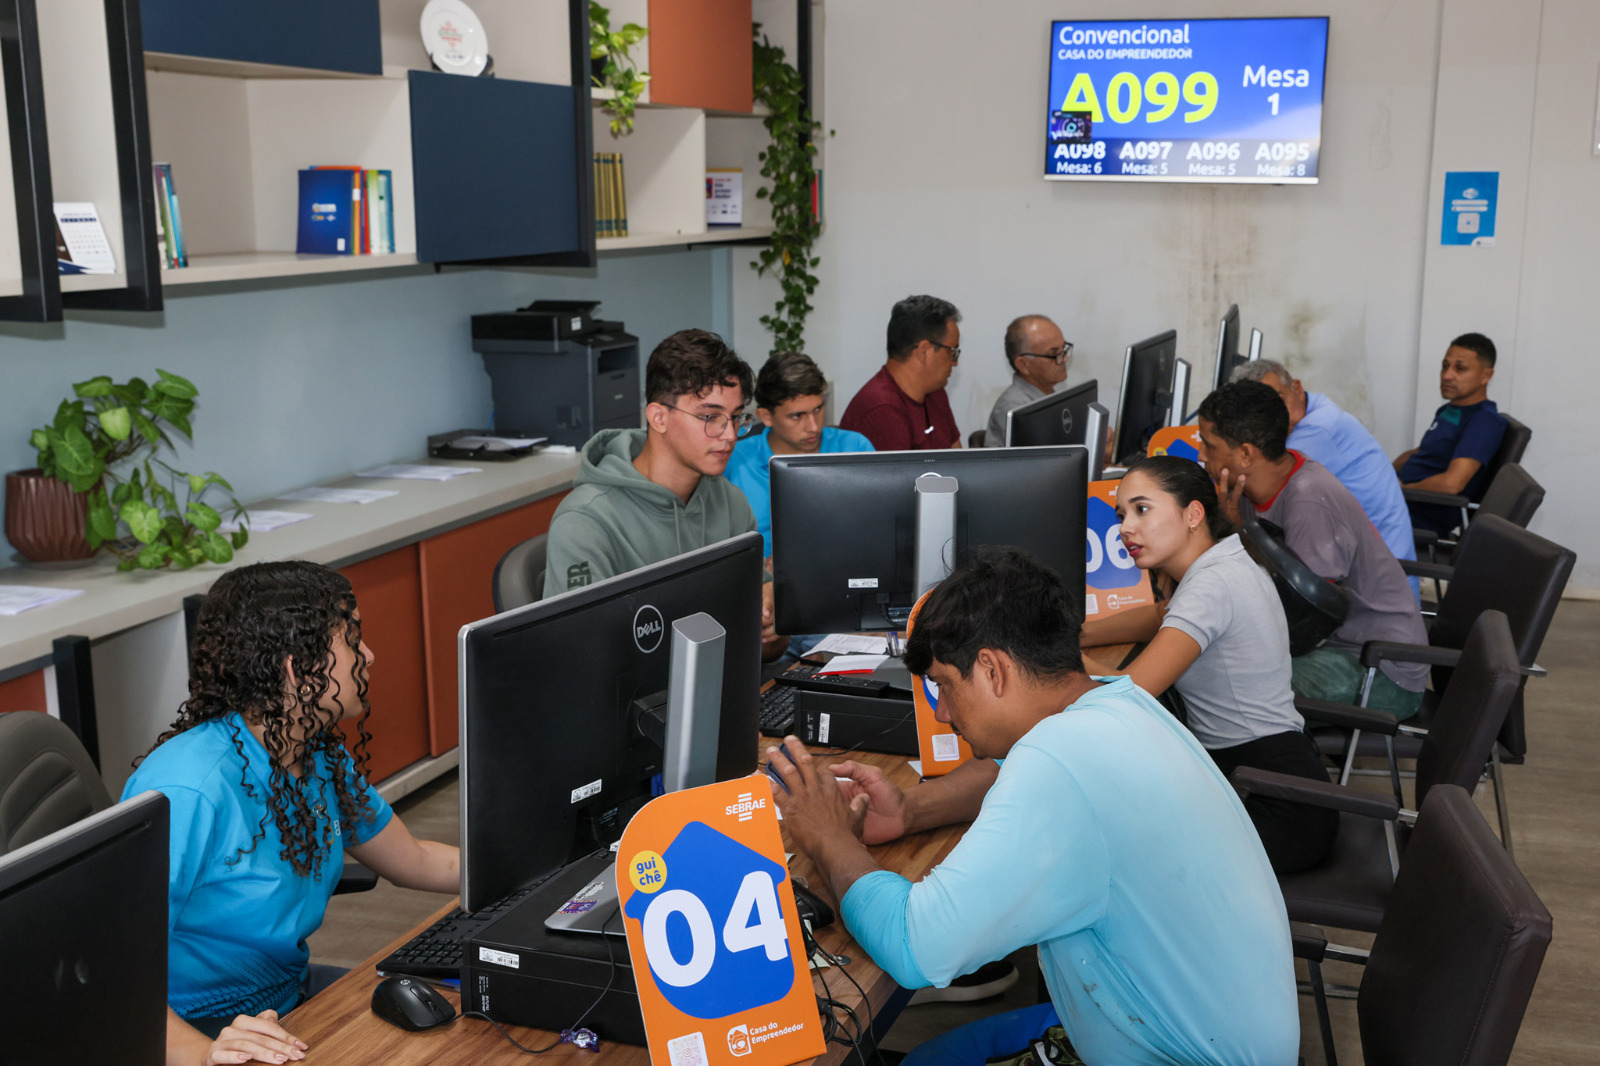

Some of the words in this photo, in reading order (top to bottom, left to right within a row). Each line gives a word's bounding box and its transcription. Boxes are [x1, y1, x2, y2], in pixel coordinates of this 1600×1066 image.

[1059, 23, 1190, 45] Convencional
[1058, 48, 1086, 60] CASA
[1087, 48, 1105, 60] DO
[1105, 47, 1193, 60] EMPREENDEDOR
[1242, 65, 1310, 88] Mesa
[1061, 71, 1219, 124] A099
[1267, 92, 1280, 116] 1
[1119, 141, 1173, 160] A097
[1186, 142, 1241, 161] A096
[1254, 142, 1310, 161] A095
[1056, 161, 1092, 174] Mesa:
[1093, 161, 1103, 174] 6
[1121, 162, 1158, 175] Mesa:
[1160, 162, 1169, 175] 5
[1188, 163, 1226, 176] Mesa:
[1227, 163, 1236, 176] 5
[1256, 164, 1294, 177] Mesa:
[636, 620, 662, 639] DELL
[725, 798, 766, 816] SEBRAE
[636, 857, 657, 875] gui
[639, 869, 662, 886] chê
[642, 870, 789, 988] 04
[749, 1025, 768, 1036] Casa
[768, 1021, 779, 1030] do
[751, 1022, 805, 1044] Empreendedor
